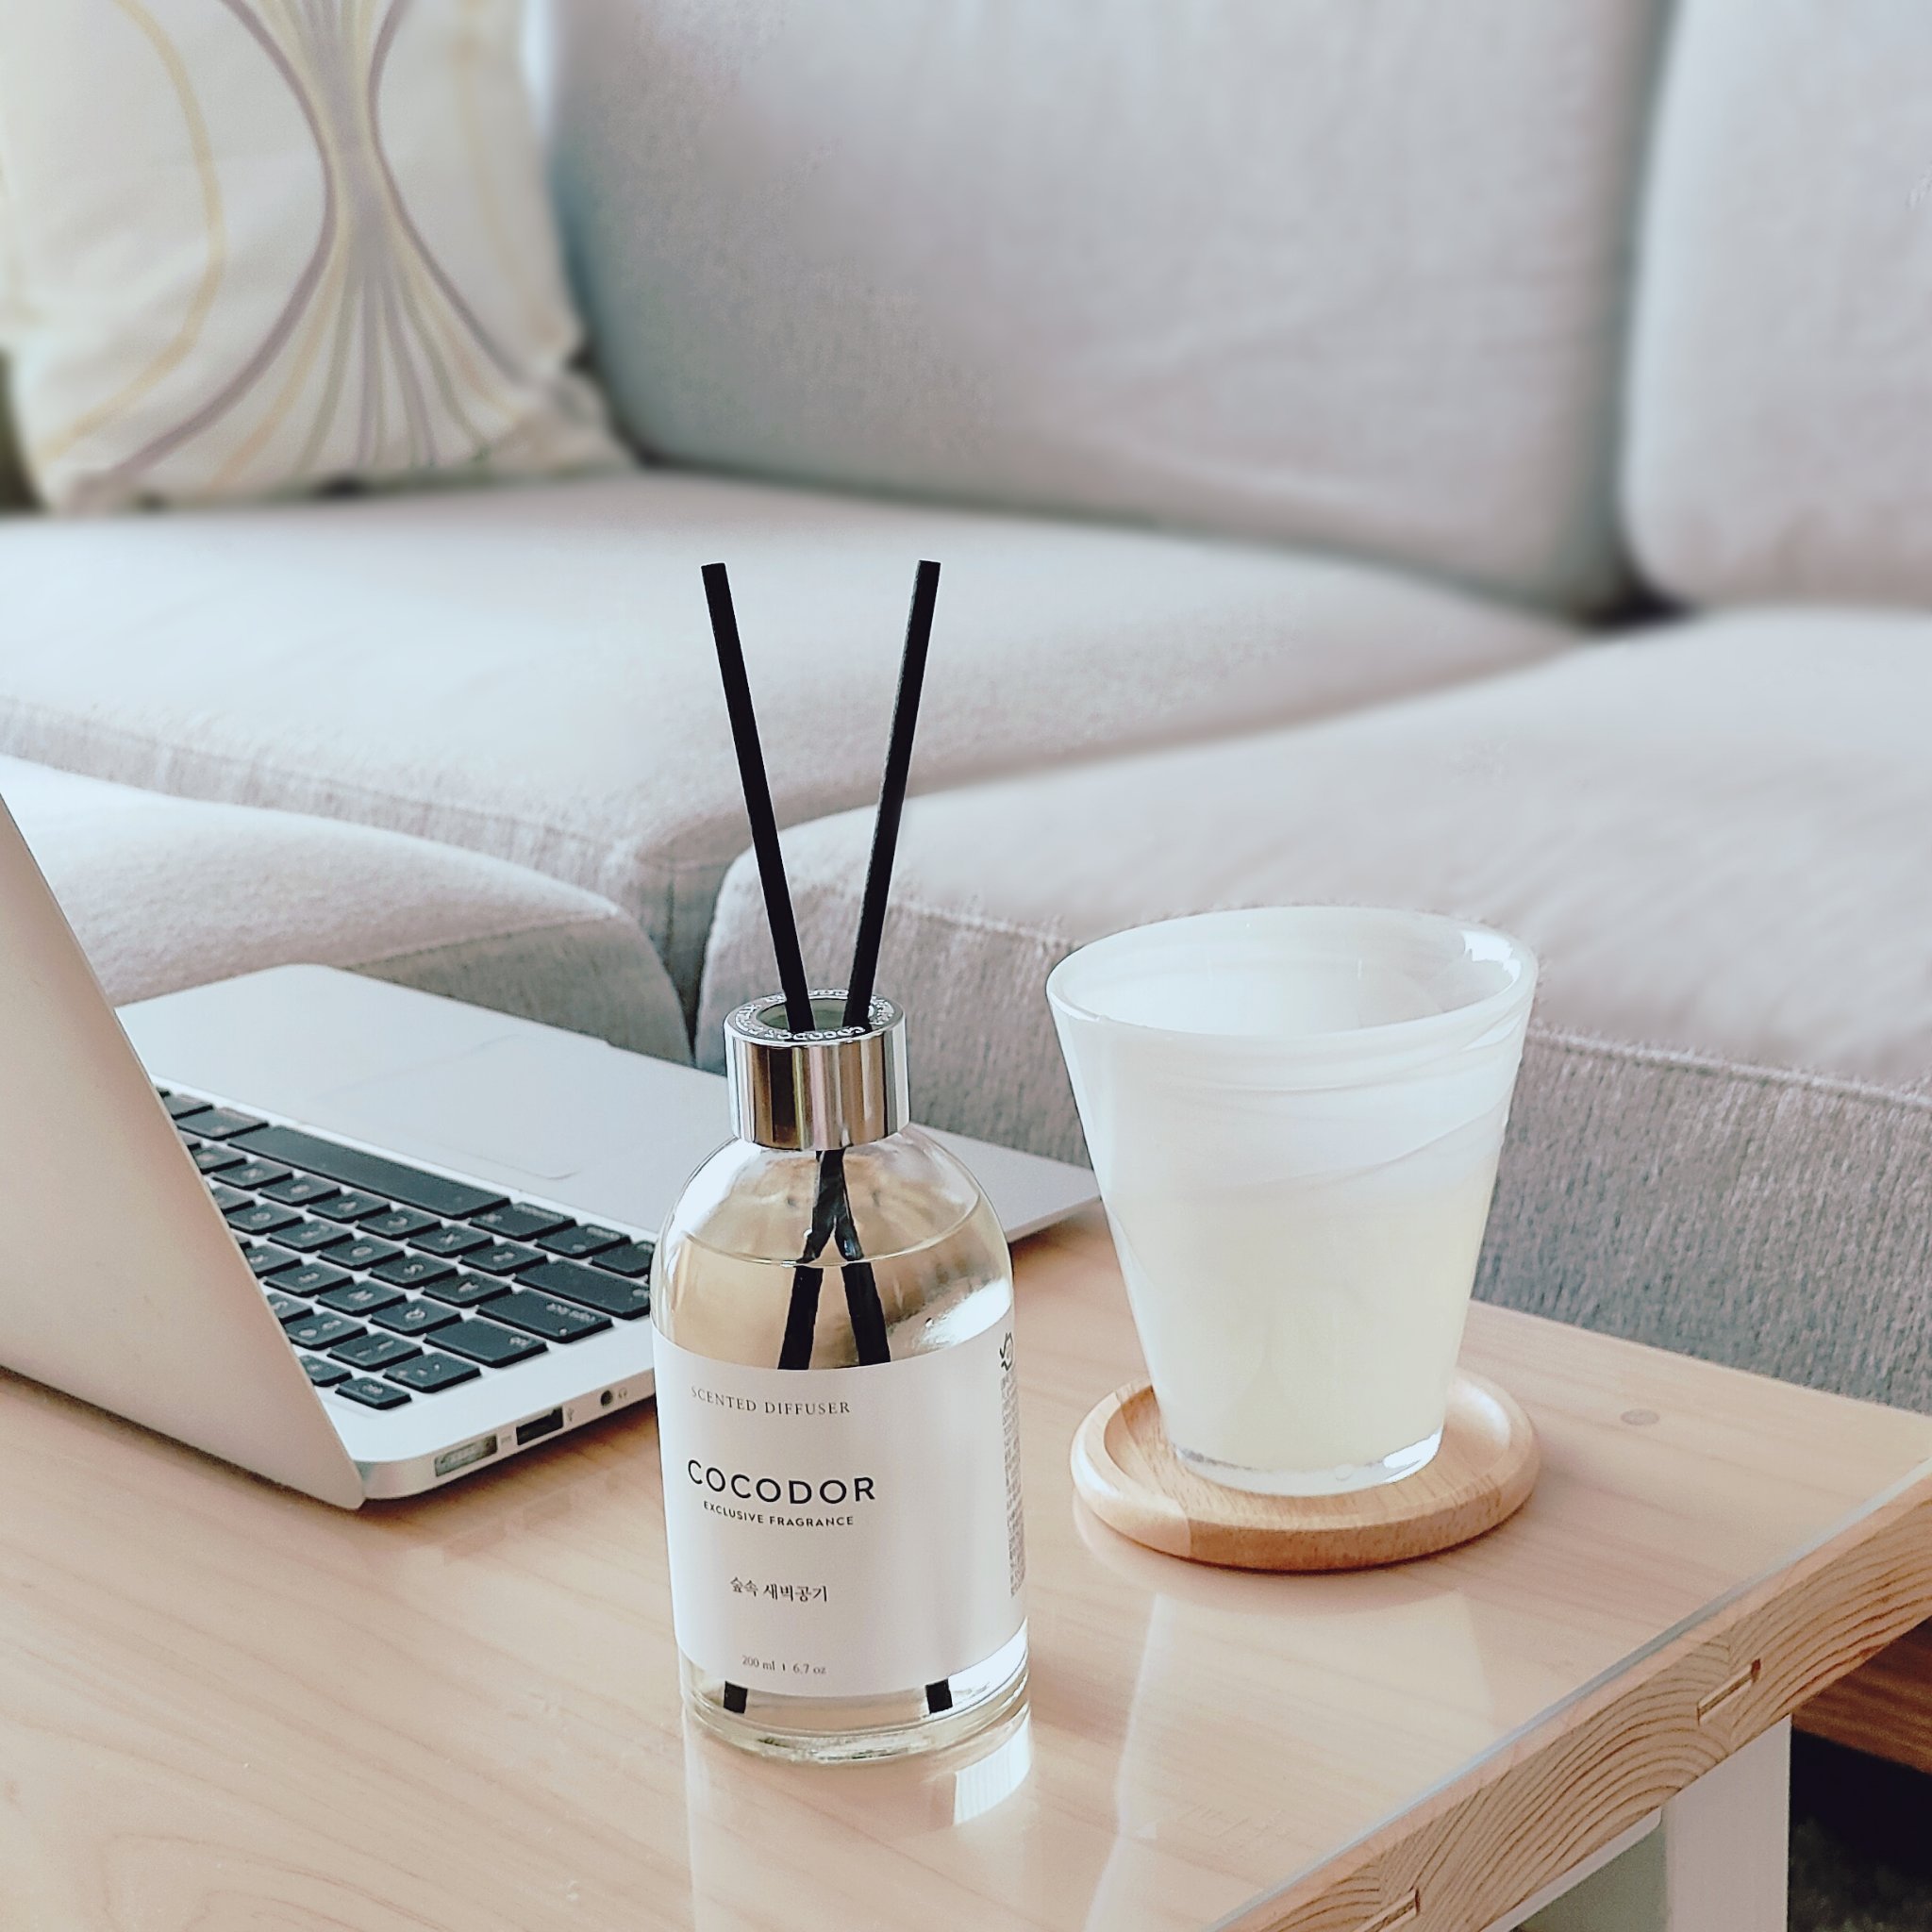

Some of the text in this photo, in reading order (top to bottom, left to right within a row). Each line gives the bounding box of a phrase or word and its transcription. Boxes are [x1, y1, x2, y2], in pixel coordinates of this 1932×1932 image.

[691, 1385, 851, 1415] SCENTED DIFFUSER
[688, 1459, 875, 1505] COCODOR
[703, 1500, 855, 1527] EXCLUSIVE FRAGRANCE
[741, 1655, 760, 1668] 200
[762, 1660, 775, 1671] ml
[792, 1663, 810, 1674] 6.7
